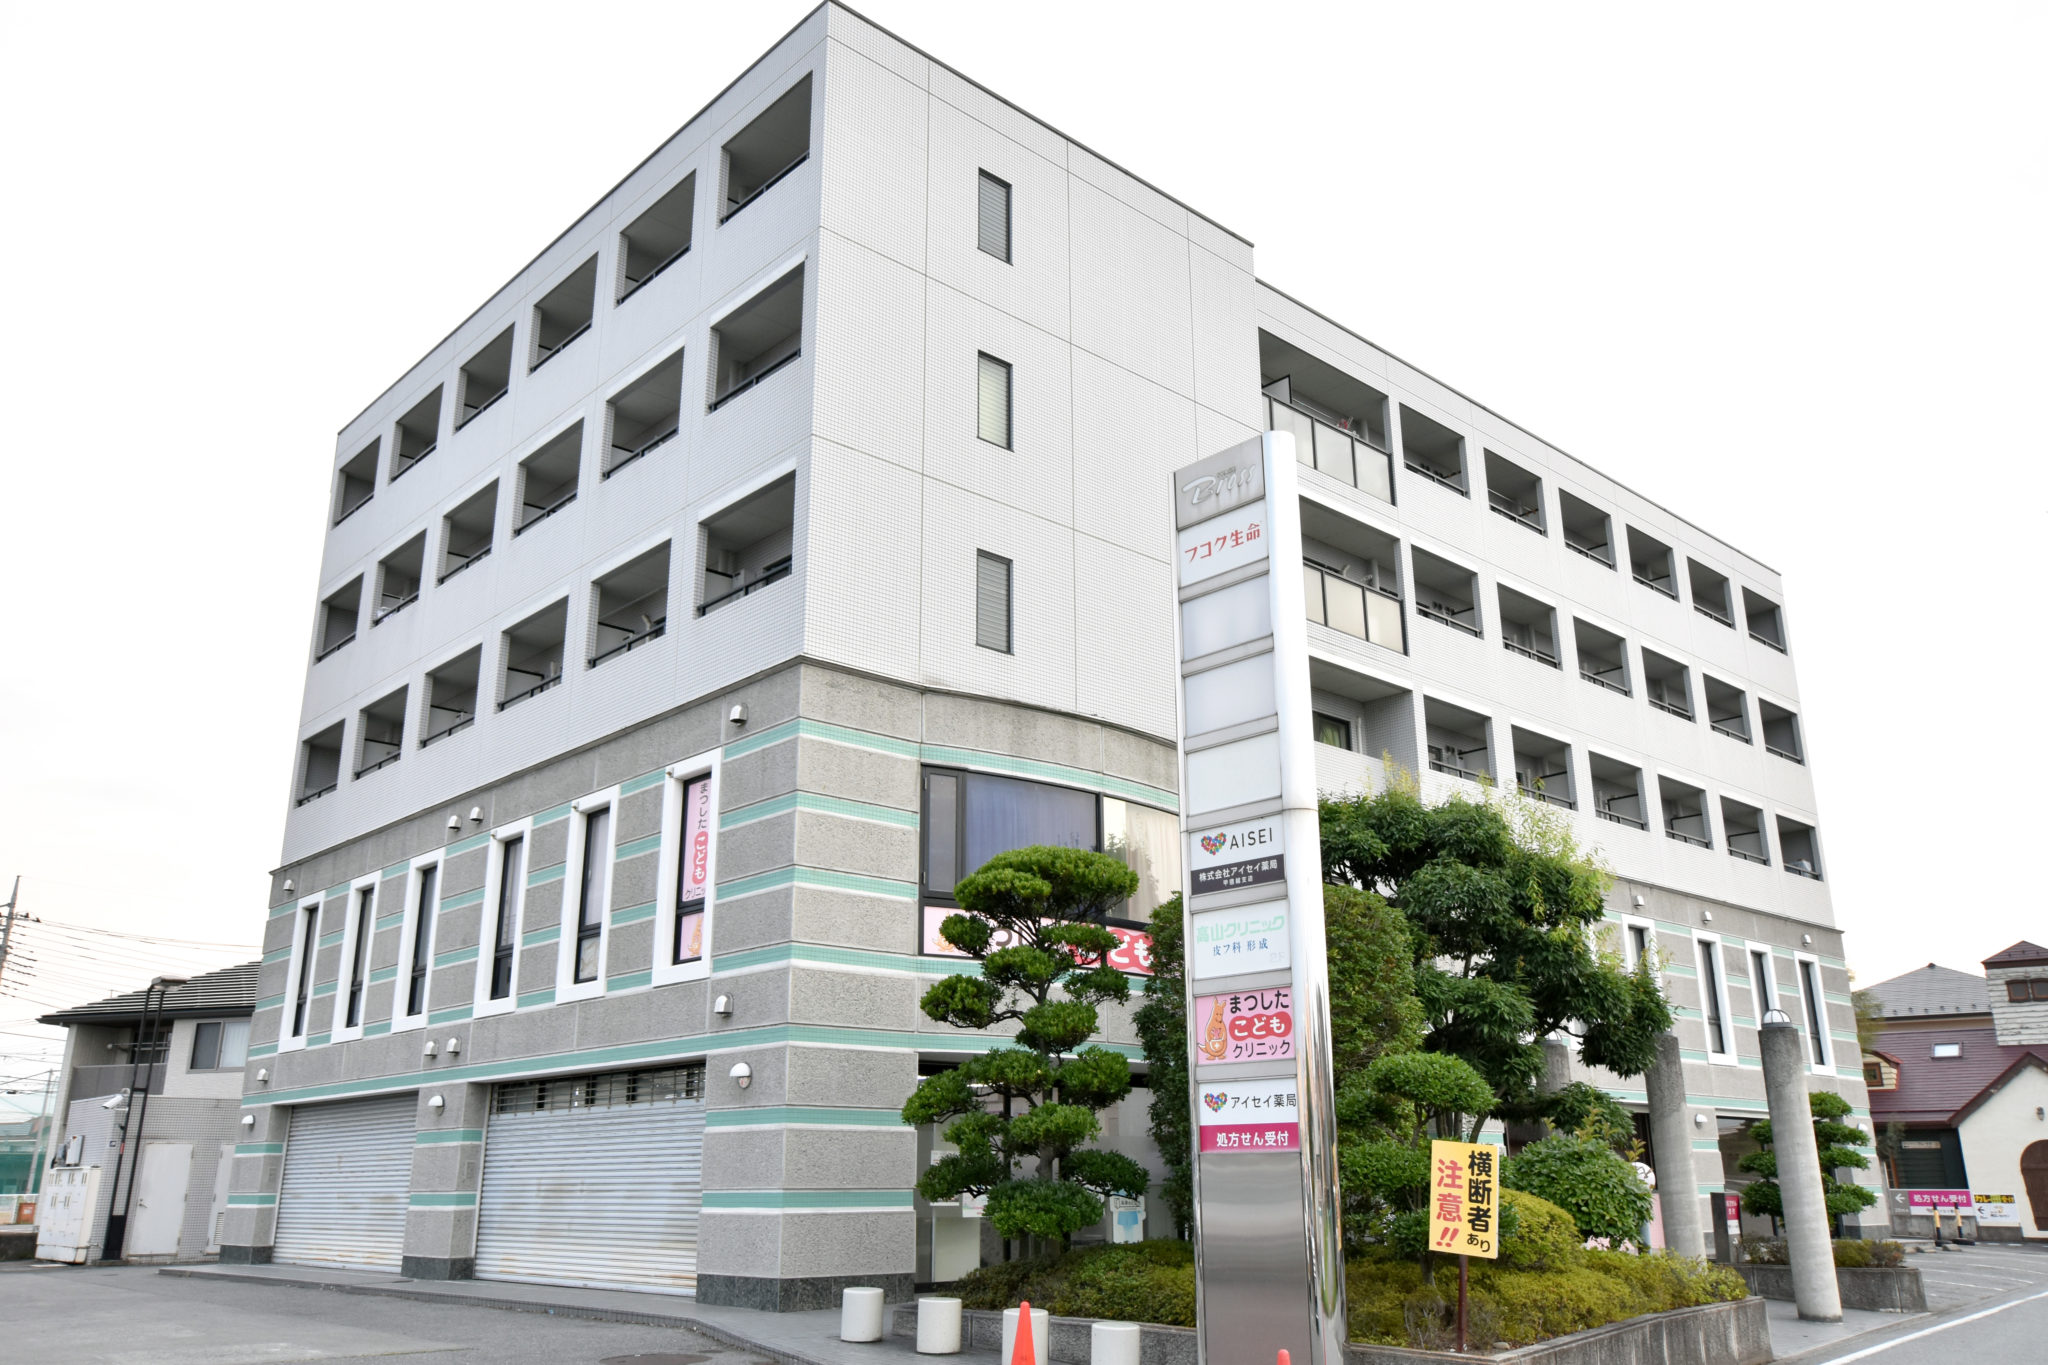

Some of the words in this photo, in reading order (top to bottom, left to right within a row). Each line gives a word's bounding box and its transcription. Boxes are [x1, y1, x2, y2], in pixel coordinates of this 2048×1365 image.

[1184, 523, 1261, 562] フコク生命
[697, 782, 709, 830] まつした
[1230, 827, 1273, 850] AISEI
[694, 836, 706, 879] こども
[1198, 859, 1278, 882] 株式会社アイセイ薬局
[1196, 915, 1285, 944] 高山クリニック
[1229, 989, 1290, 1014] まつした
[1234, 1015, 1286, 1037] こども
[1233, 1039, 1291, 1059] クリニック
[1231, 1093, 1297, 1109] アイセイ薬局
[1216, 1131, 1289, 1147] 処方せん受付
[1913, 1194, 1967, 1203] 処方せん受付
